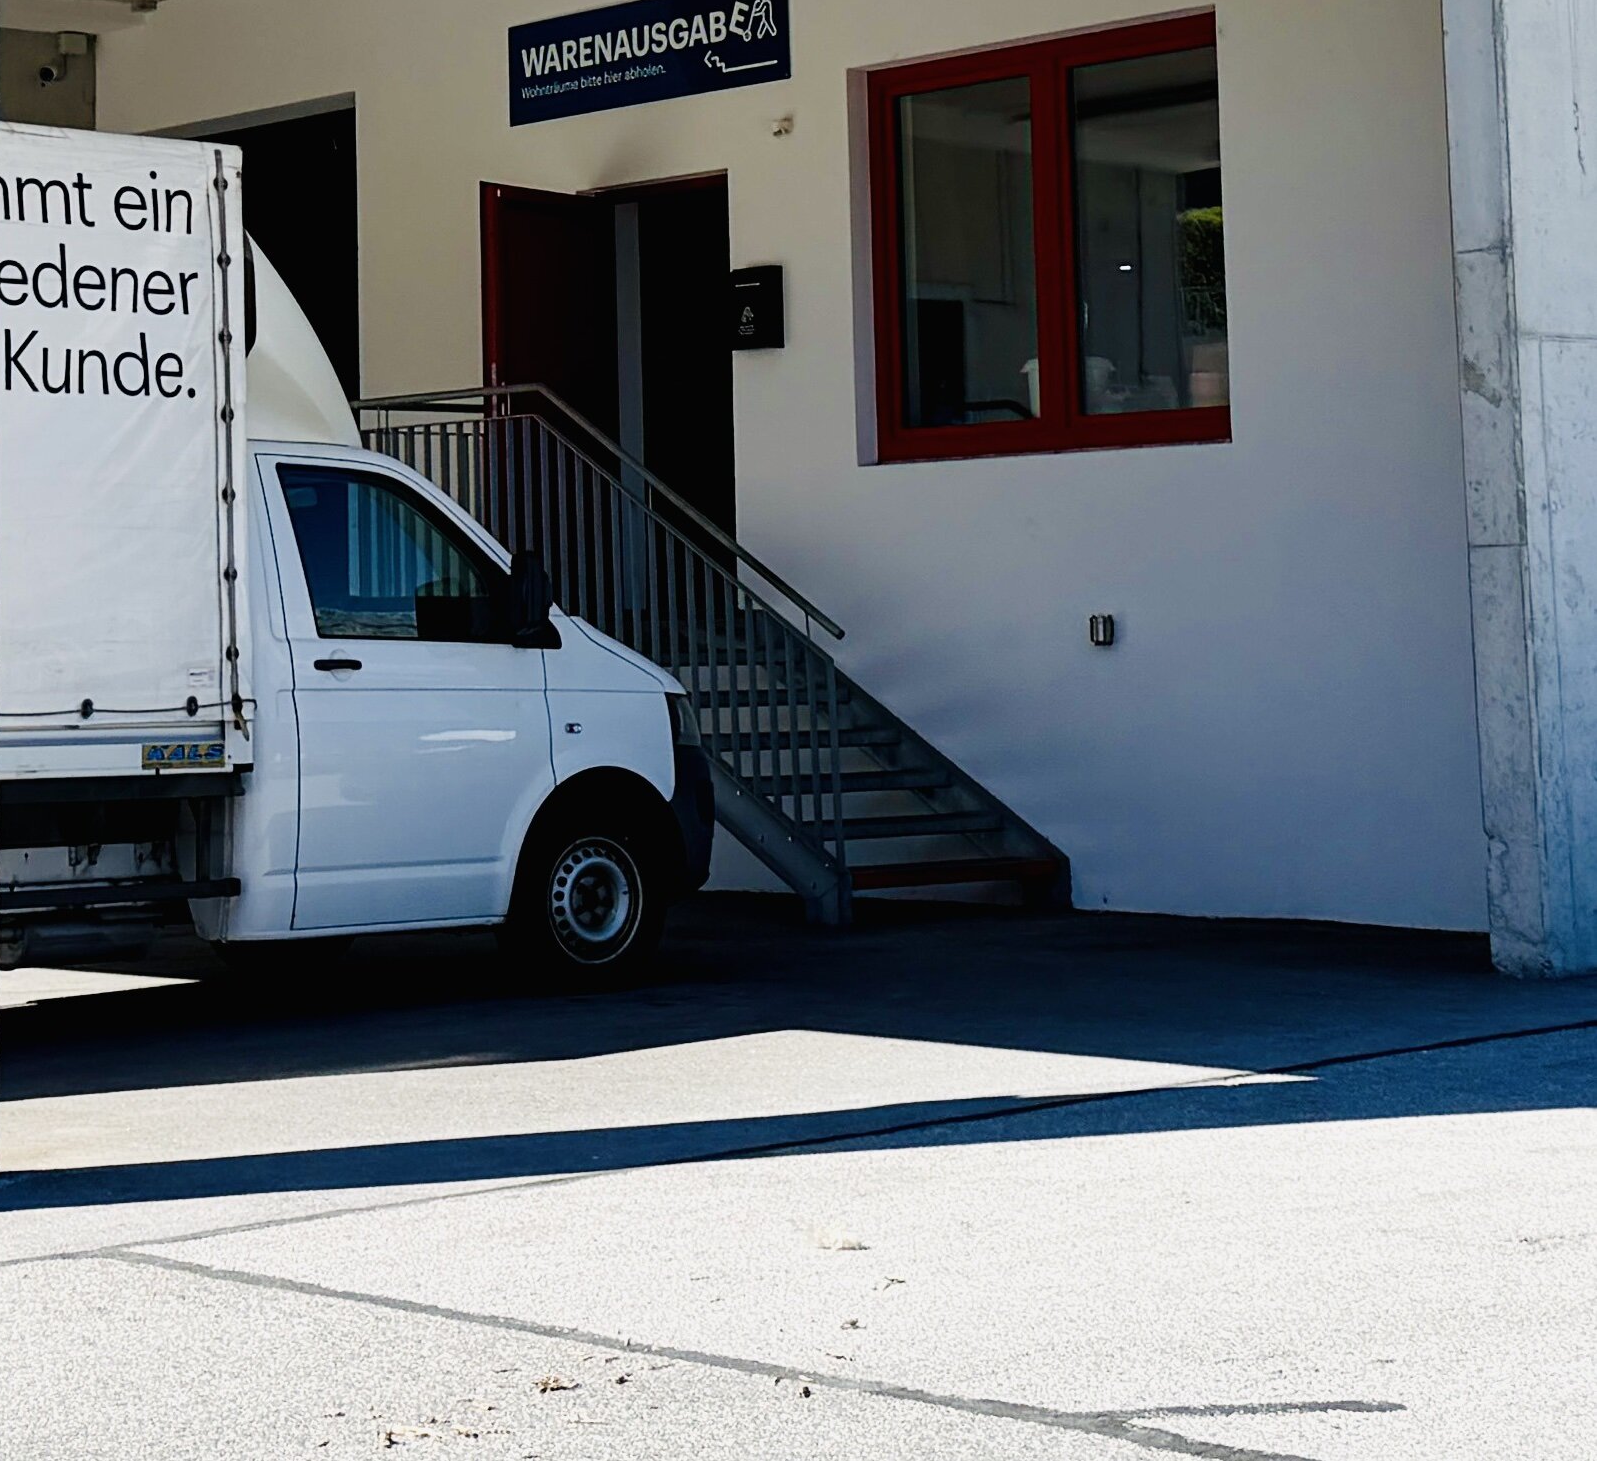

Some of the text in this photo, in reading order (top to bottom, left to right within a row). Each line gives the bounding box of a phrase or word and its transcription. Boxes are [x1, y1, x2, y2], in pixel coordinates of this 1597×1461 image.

[521, 0, 749, 78] WARENAUSGABE
[580, 74, 602, 89] bitte
[604, 70, 622, 85] hier
[114, 170, 192, 235] ein
[4, 328, 196, 399] Kunde.
